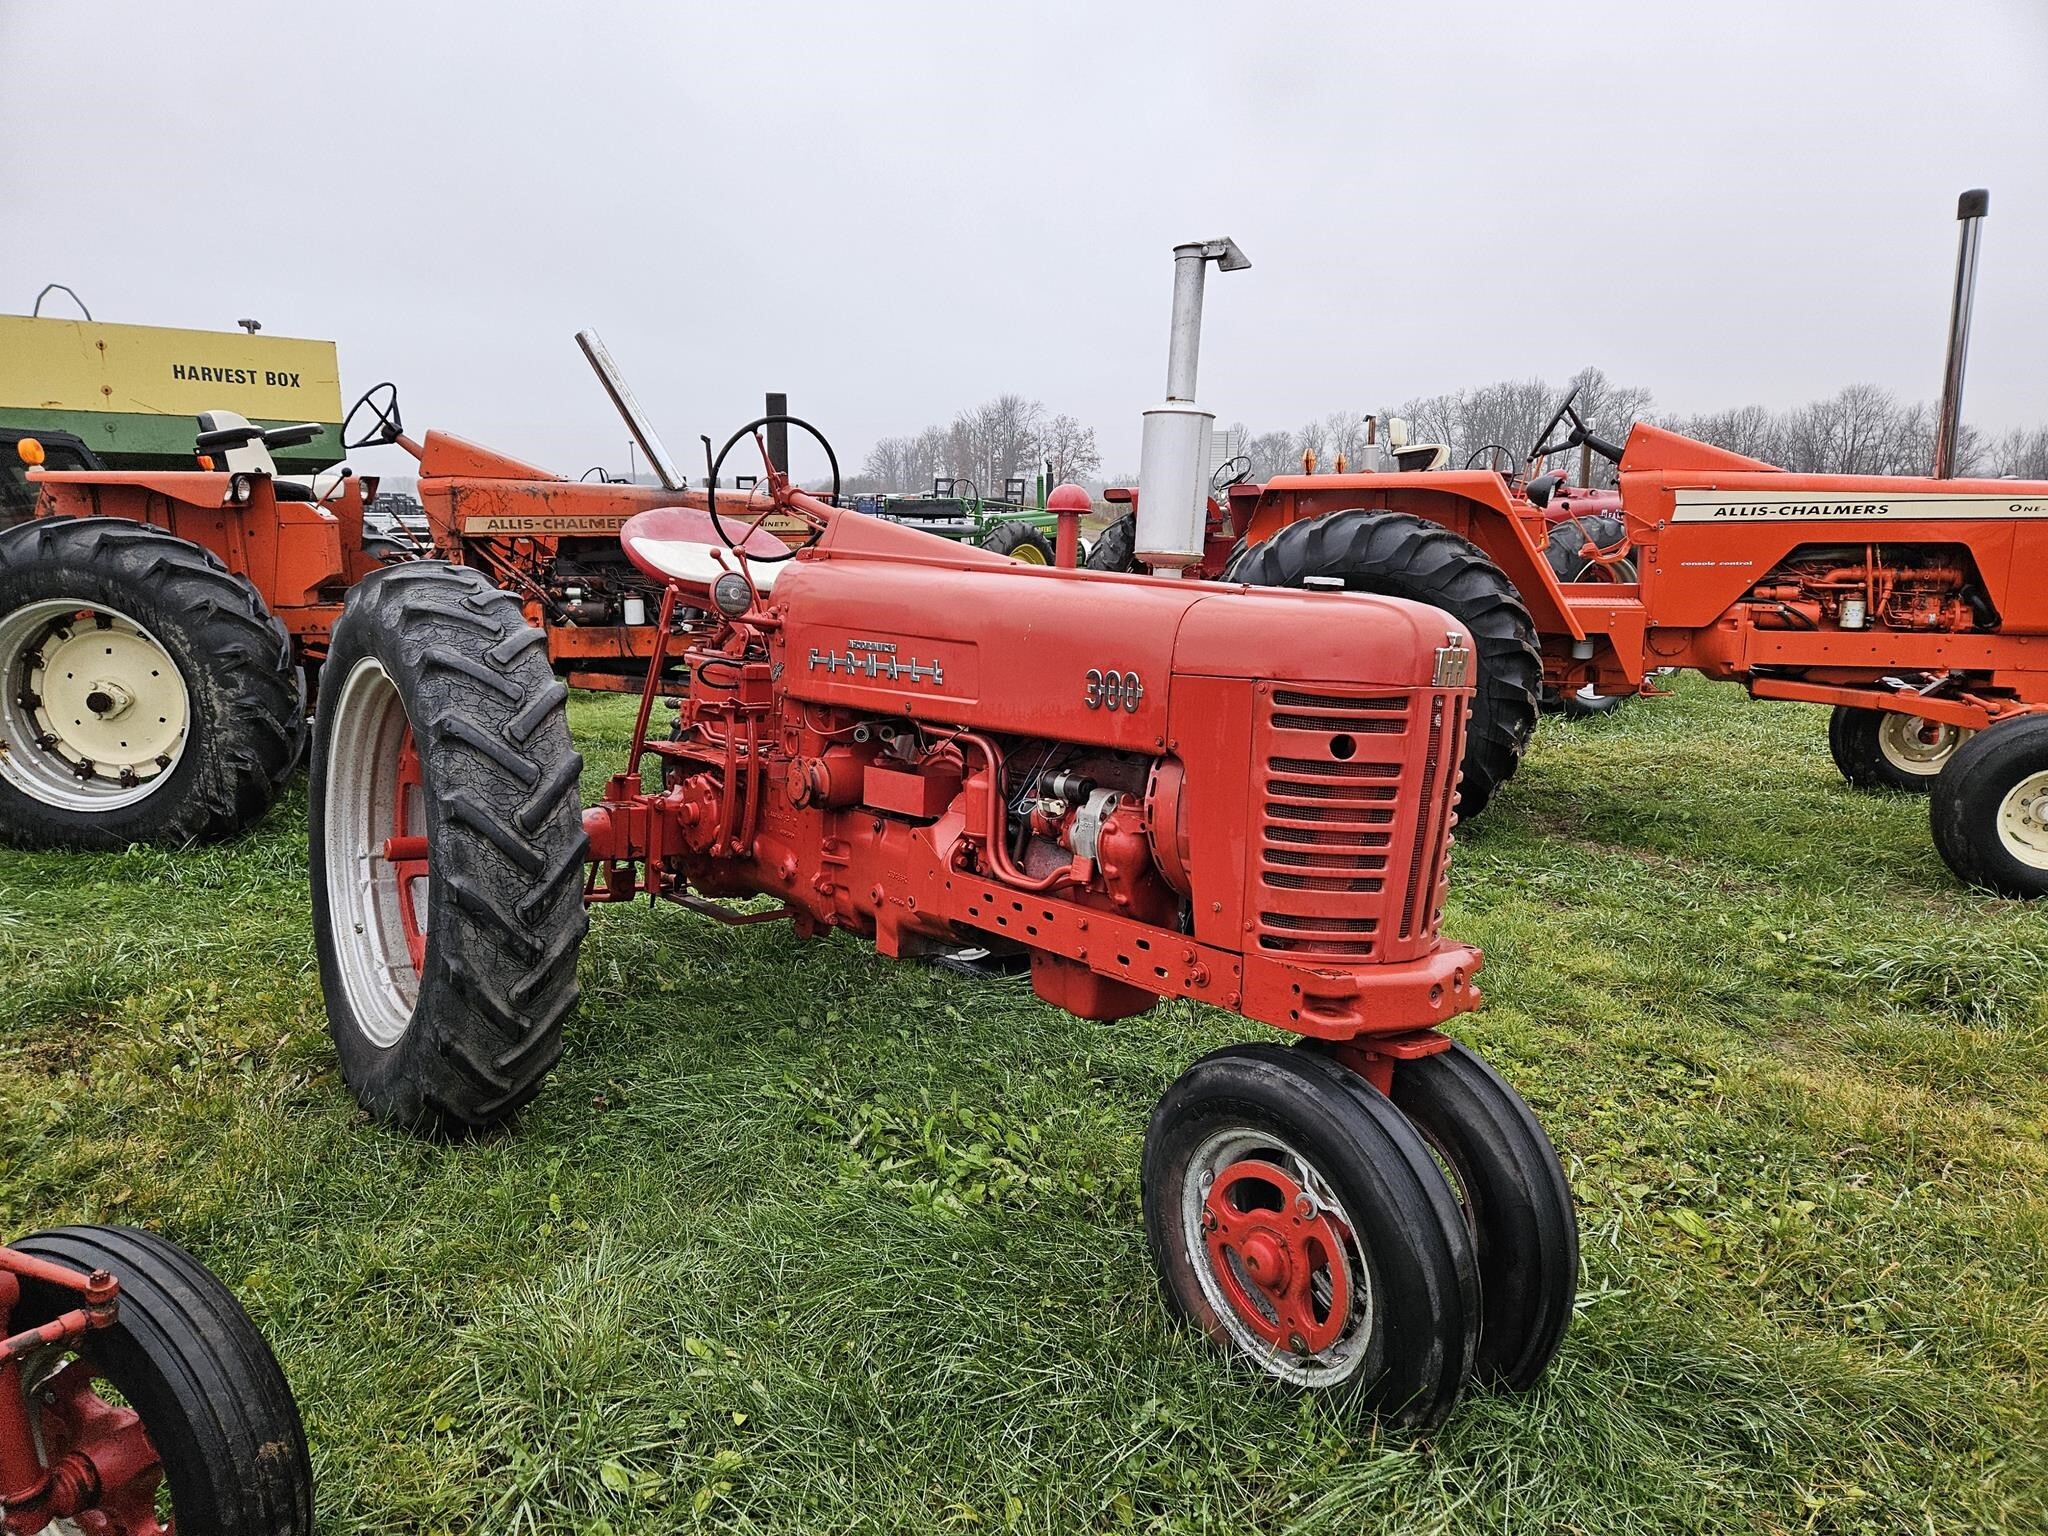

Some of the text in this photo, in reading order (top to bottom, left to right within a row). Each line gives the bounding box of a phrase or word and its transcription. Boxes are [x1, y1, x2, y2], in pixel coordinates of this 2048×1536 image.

[173, 364, 300, 387] HARVEST BOX
[1713, 504, 1889, 517] ALLIS-CHALMERS
[487, 518, 628, 530] ALLIS-CHALMER
[808, 648, 943, 685] FARMALL
[1084, 668, 1140, 714] 300
